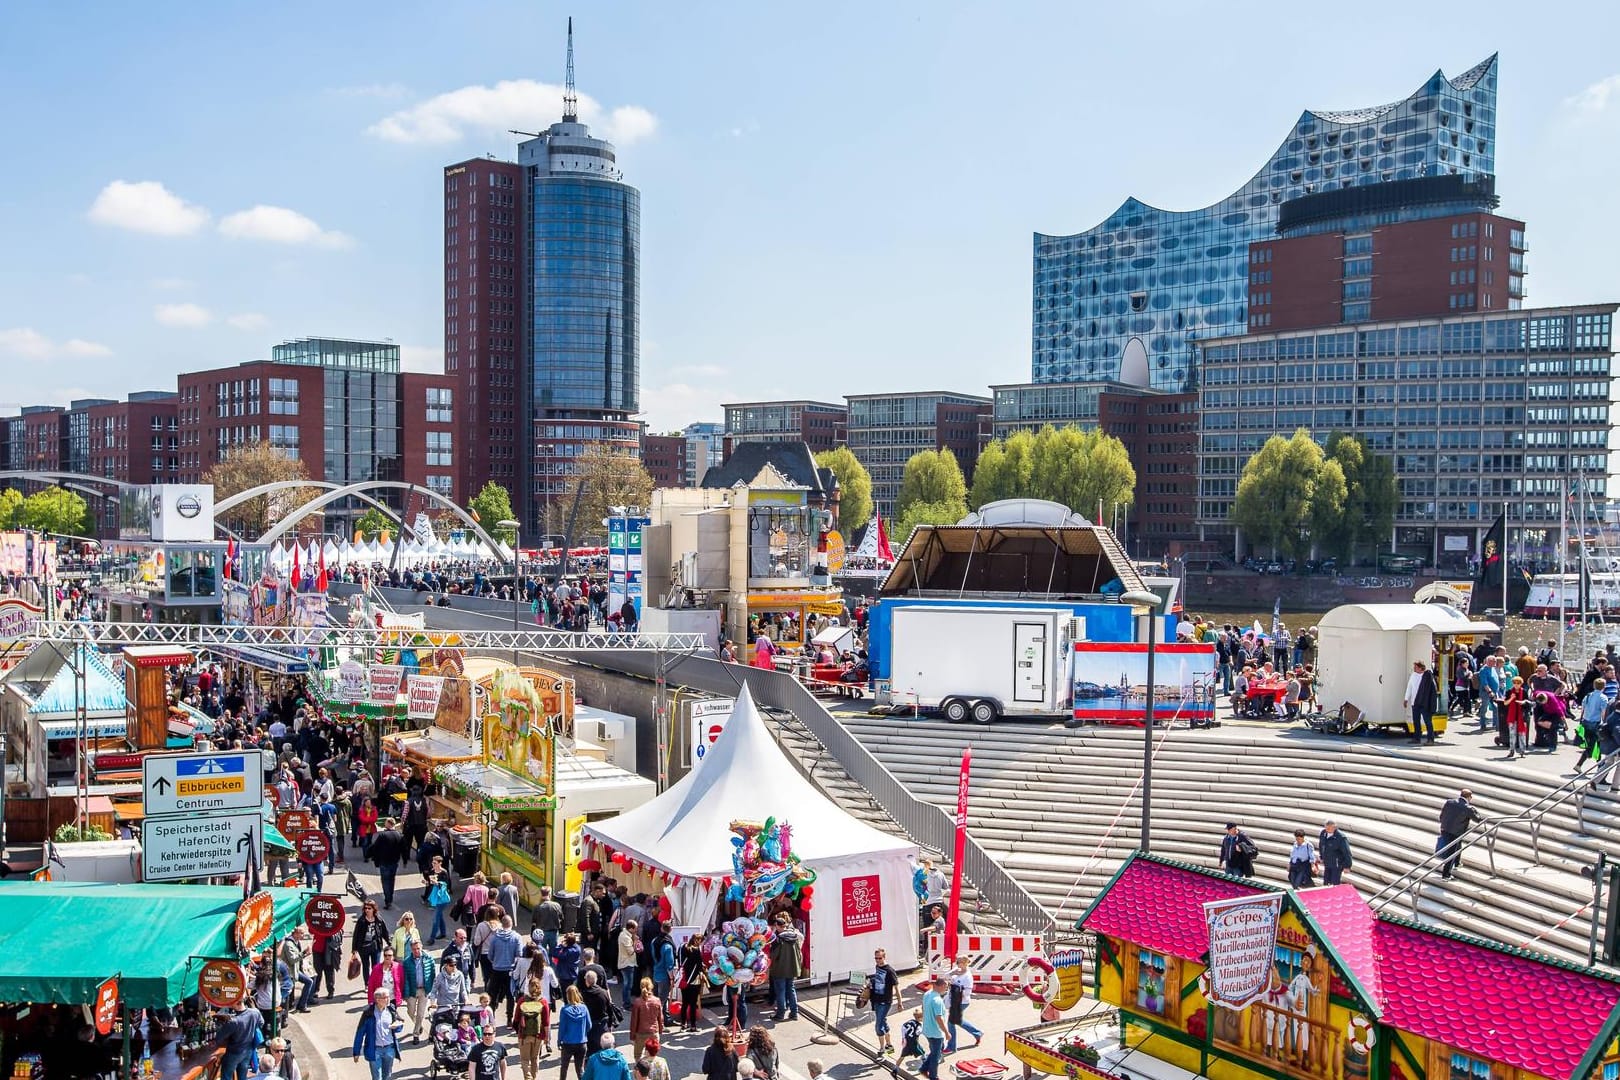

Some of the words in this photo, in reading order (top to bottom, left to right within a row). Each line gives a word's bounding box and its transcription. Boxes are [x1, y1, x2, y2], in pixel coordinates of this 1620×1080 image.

[180, 780, 241, 793] Elbbrücken
[177, 799, 223, 809] Centrum
[155, 821, 232, 838] Speicherstadt
[178, 834, 232, 847] HafenCity
[161, 847, 232, 861] Kehrwiederspitze
[149, 864, 171, 874] Cruise
[174, 862, 196, 872] Center
[199, 860, 232, 870] HafenCity
[317, 901, 333, 911] Bier
[321, 910, 339, 920] Fass
[1224, 911, 1263, 927] Crêpes
[1214, 925, 1271, 941] Kaiserschmarrn
[1215, 936, 1269, 954] Marillenknödel
[1215, 950, 1267, 967] Erdbeerknödel
[1219, 963, 1263, 979] Minihupferl
